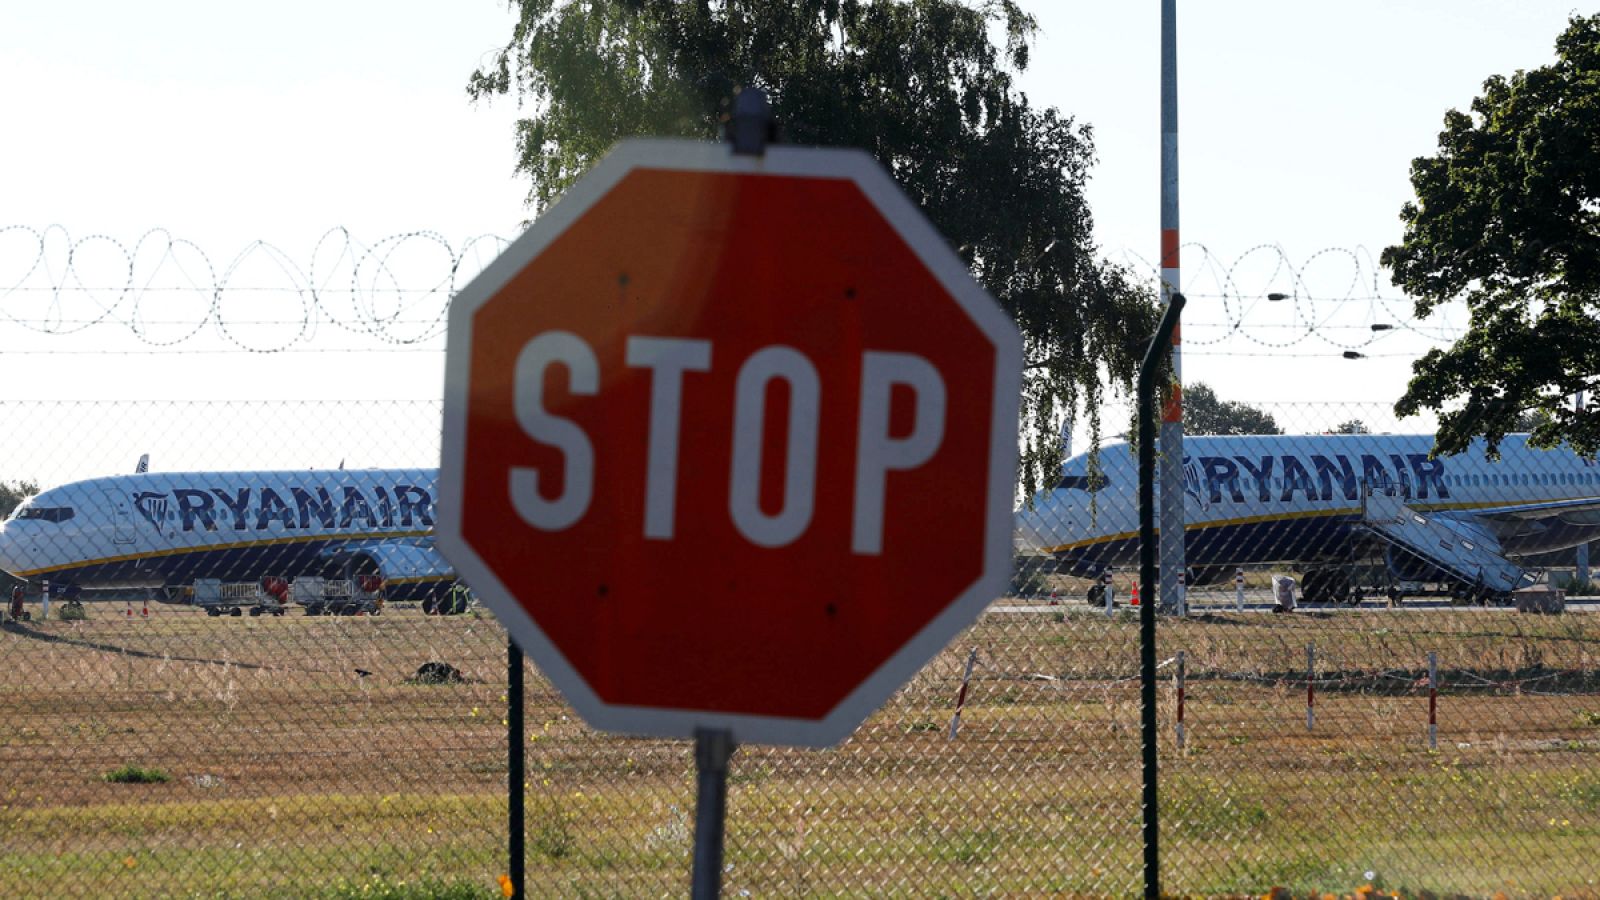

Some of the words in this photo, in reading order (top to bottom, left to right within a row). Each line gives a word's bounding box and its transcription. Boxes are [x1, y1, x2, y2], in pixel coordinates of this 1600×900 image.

[509, 331, 946, 555] STOP
[1198, 454, 1450, 503] RYANAIR
[173, 485, 434, 531] RYANAIR
